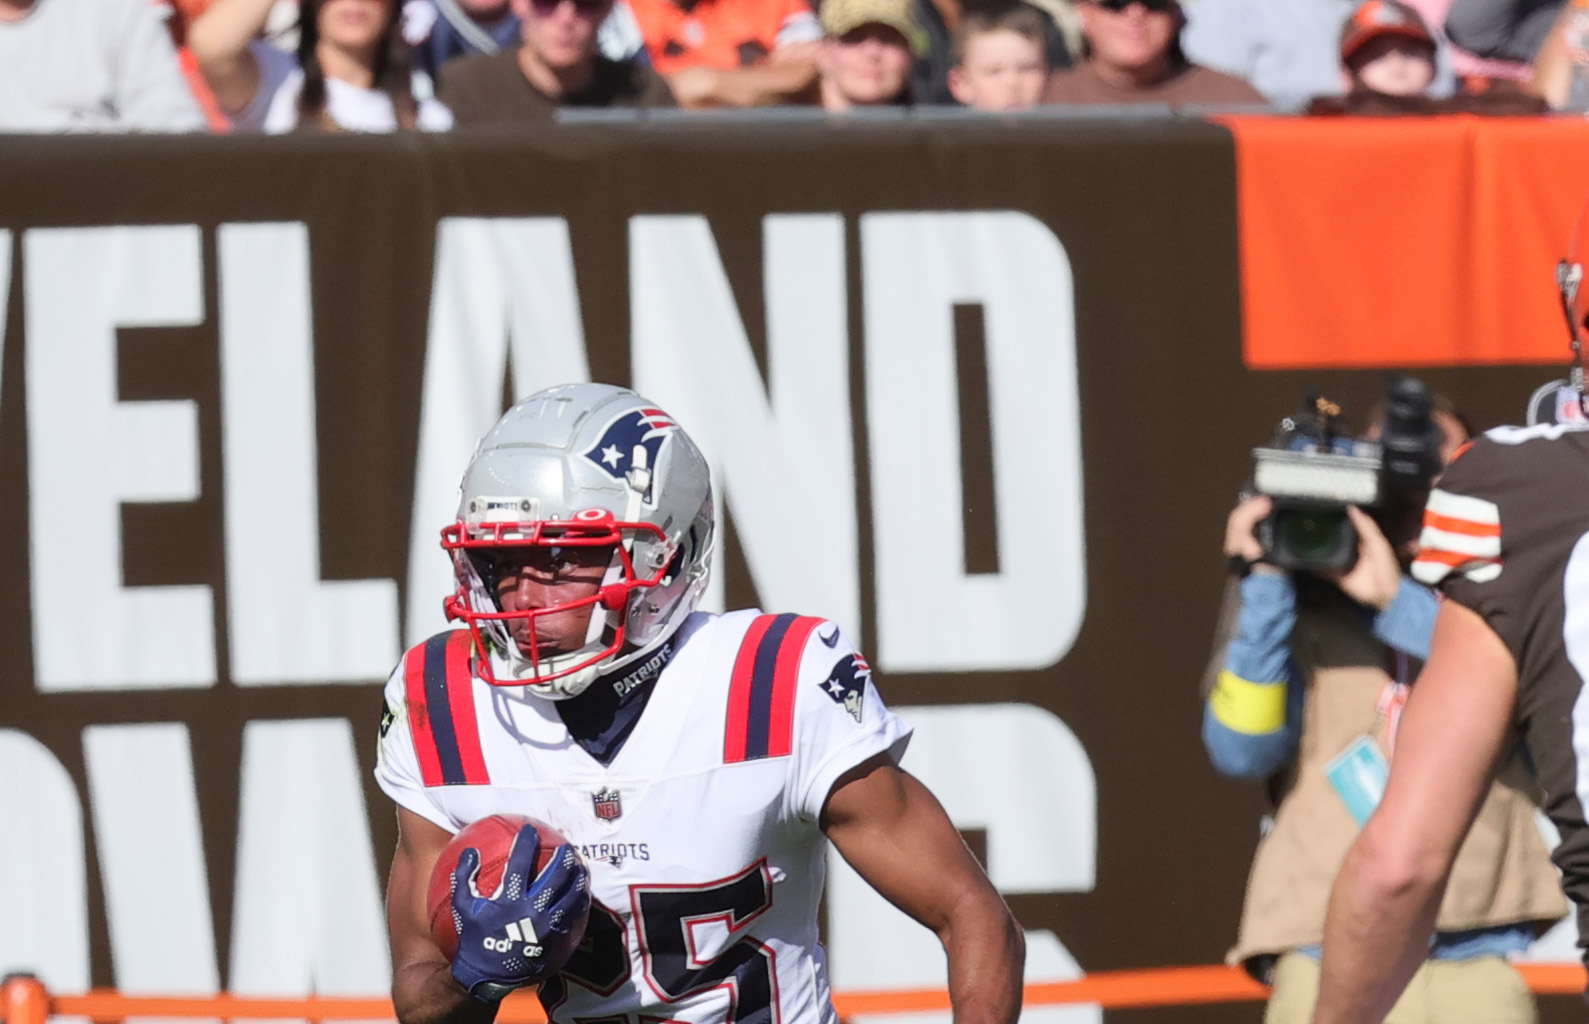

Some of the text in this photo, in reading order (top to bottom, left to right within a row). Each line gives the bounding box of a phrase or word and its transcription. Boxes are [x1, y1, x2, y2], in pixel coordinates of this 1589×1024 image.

[0, 210, 1088, 693] ELAND
[612, 644, 673, 698] PATRIOTS
[483, 936, 544, 958] adias
